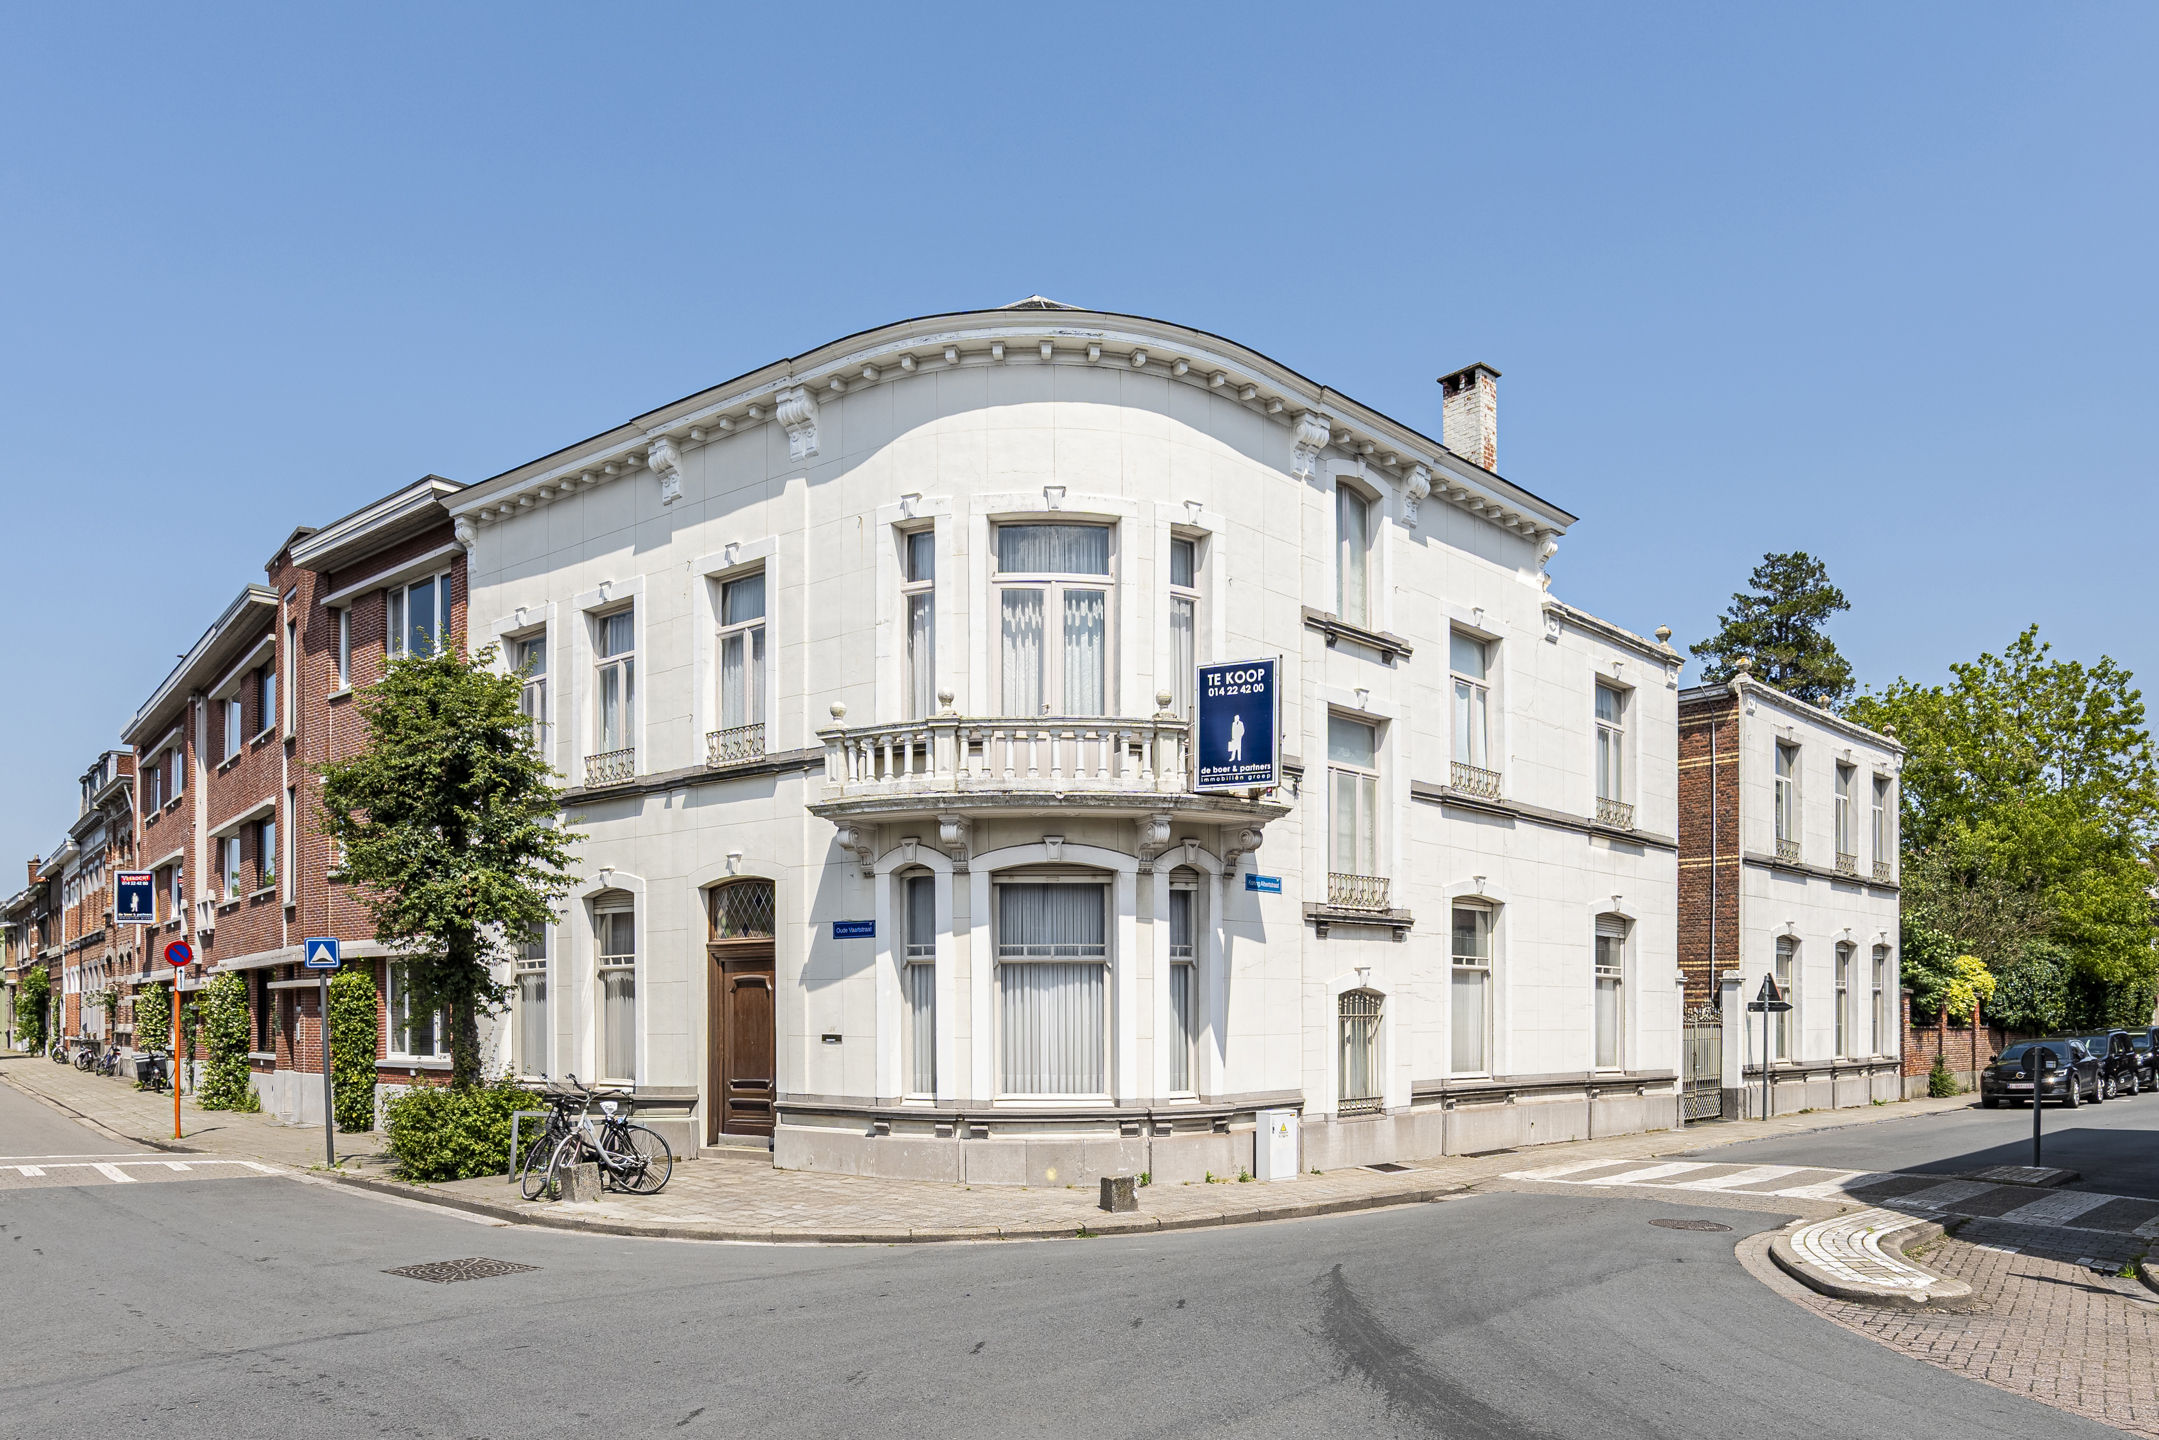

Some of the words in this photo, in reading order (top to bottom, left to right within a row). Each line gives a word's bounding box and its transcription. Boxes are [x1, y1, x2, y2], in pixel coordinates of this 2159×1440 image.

[1207, 673, 1221, 686] TE
[1225, 668, 1265, 684] KOOP
[1208, 686, 1225, 697] 014
[1226, 685, 1239, 696] 22
[1240, 684, 1252, 694] 42
[1253, 683, 1264, 693] 00
[1201, 766, 1211, 774] de
[1212, 766, 1230, 774] boer
[1240, 764, 1271, 773] partners
